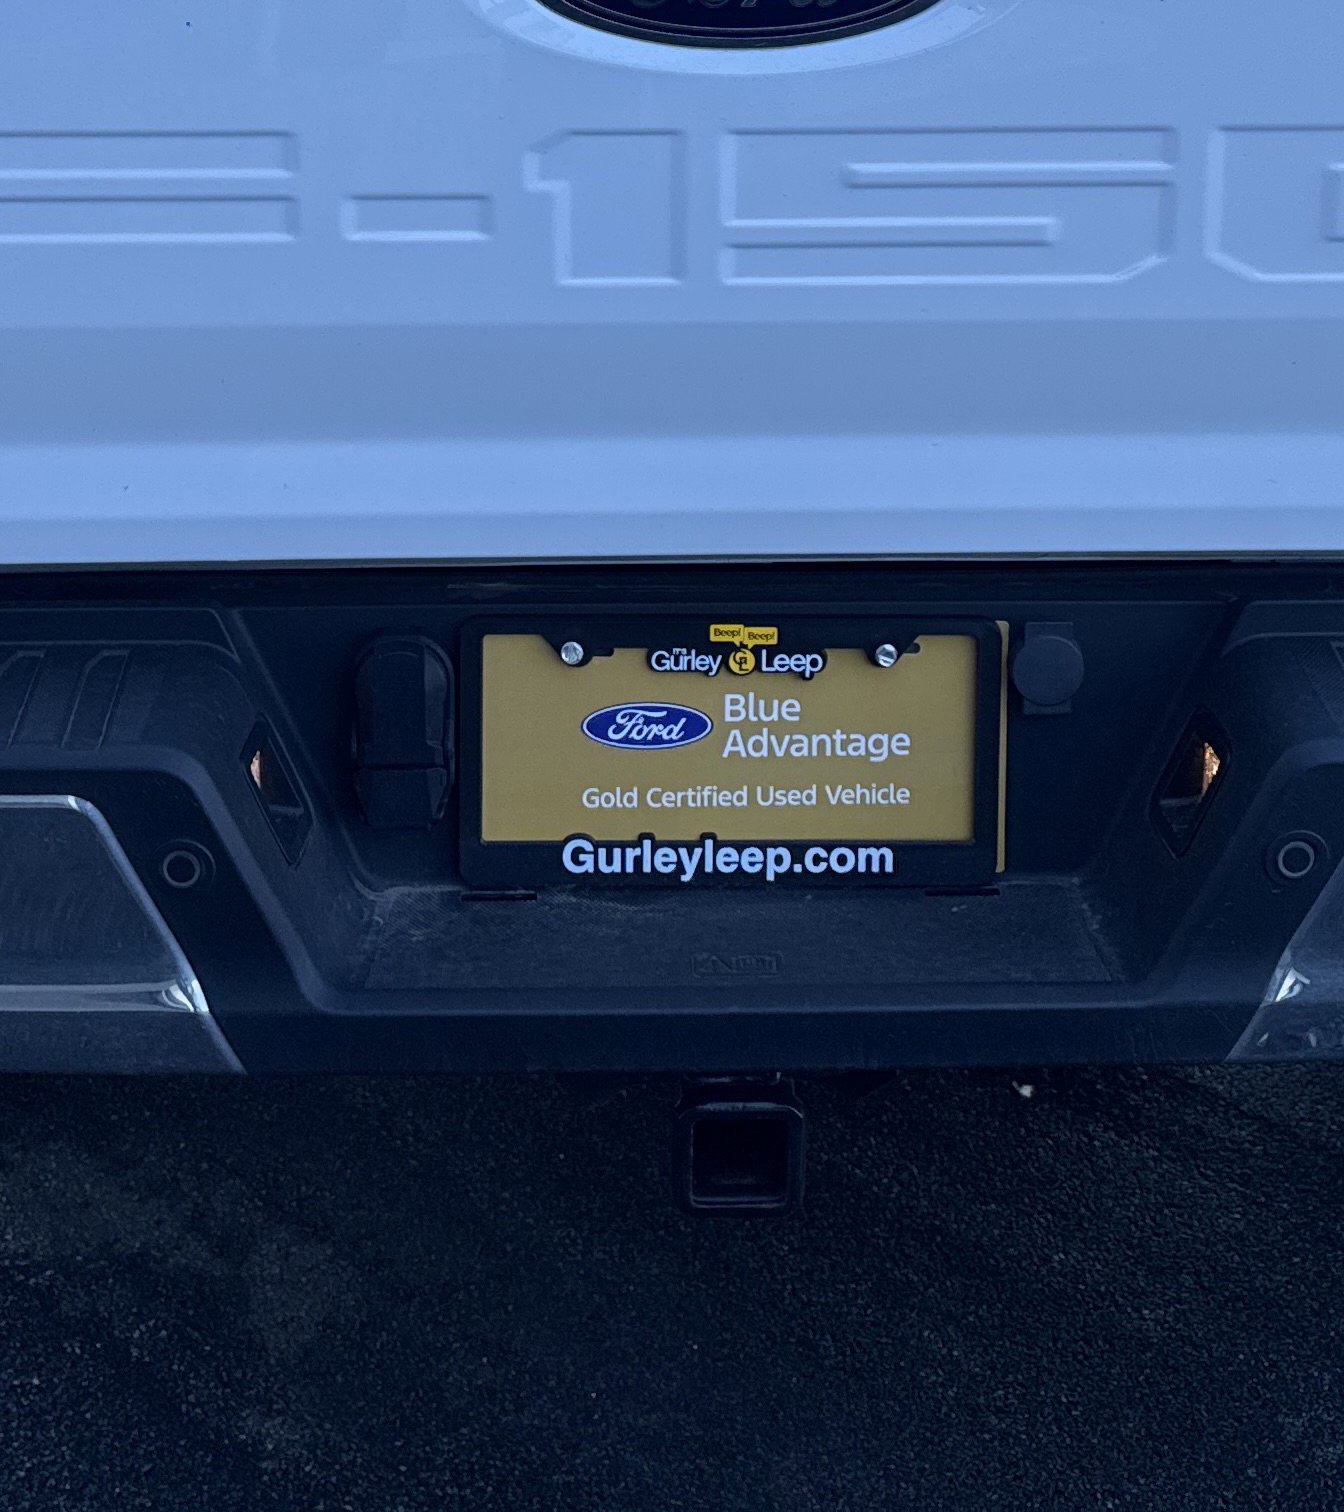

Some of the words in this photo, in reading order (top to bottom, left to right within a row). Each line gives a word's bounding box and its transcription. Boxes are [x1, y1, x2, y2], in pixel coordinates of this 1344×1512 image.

[713, 627, 741, 639] Beep!
[747, 631, 776, 643] Beep!
[650, 648, 723, 677] Gurley
[761, 648, 824, 678] Leep
[722, 692, 802, 723] Blue
[607, 708, 686, 744] Ford
[721, 728, 911, 762] Advantage
[581, 787, 639, 809] Gold
[645, 785, 749, 808] Certified
[756, 785, 818, 807] Used
[824, 783, 911, 806] Vehicle
[561, 838, 895, 882] Gurleyleep.com
